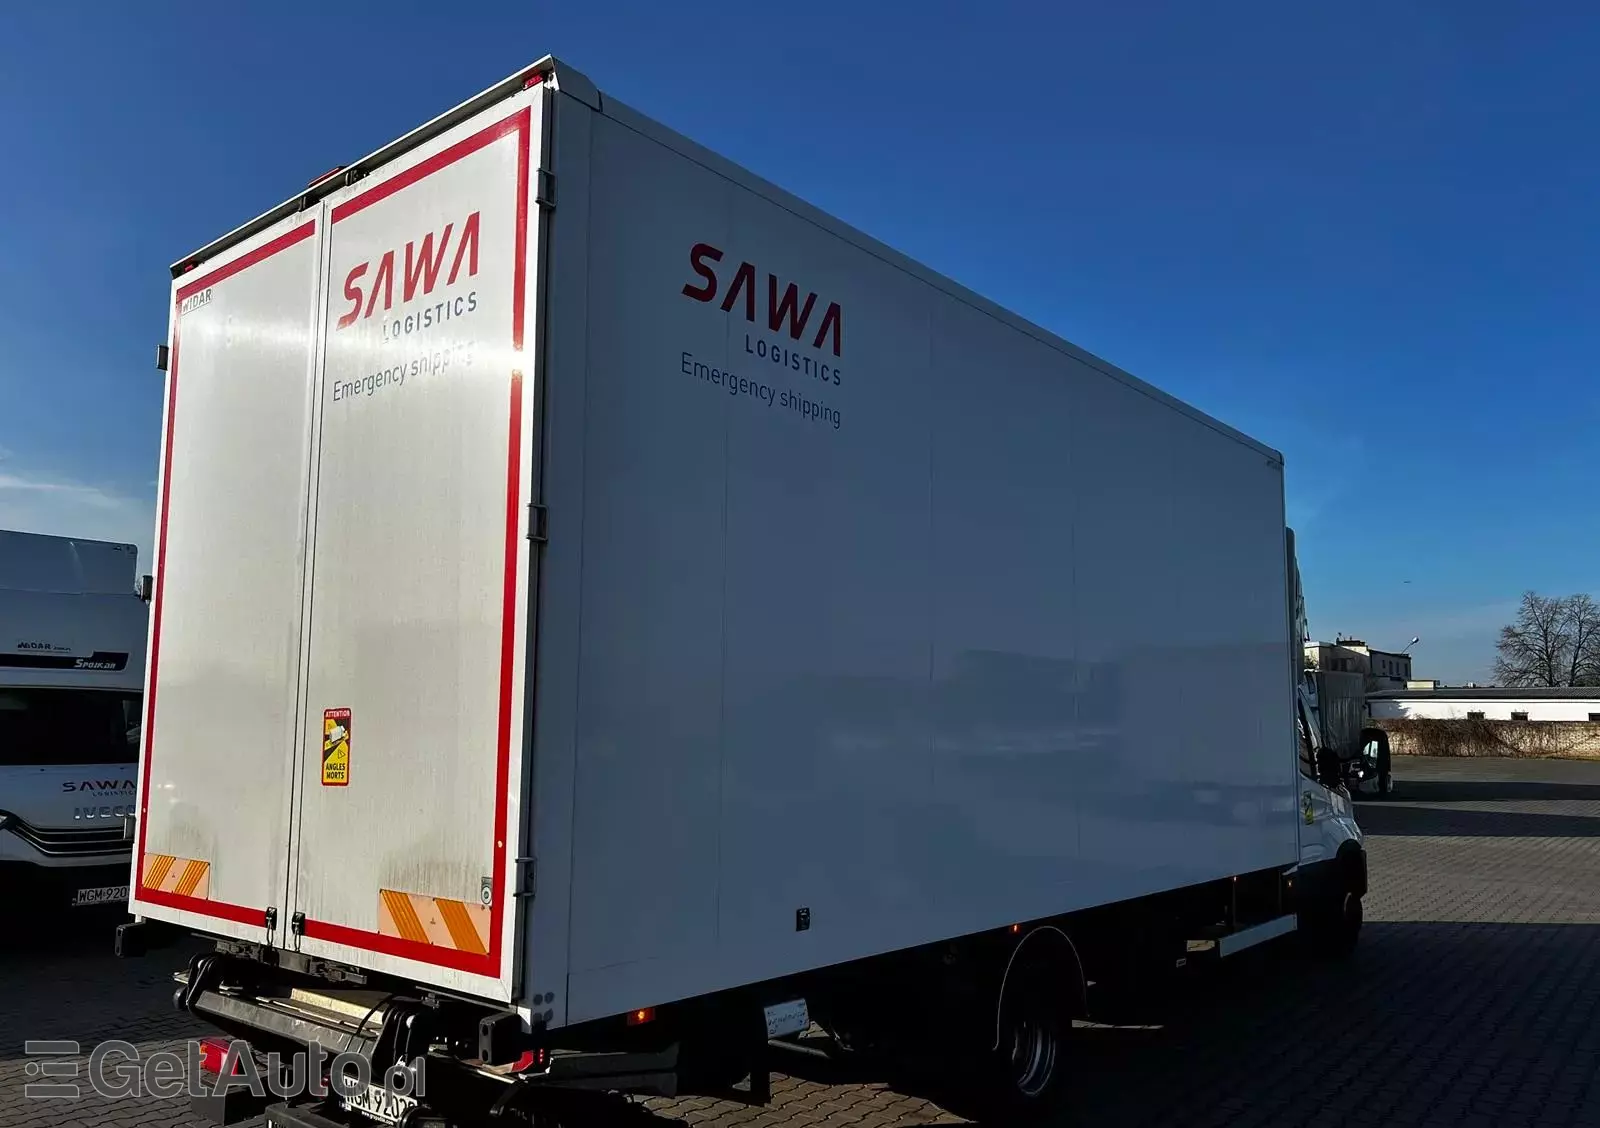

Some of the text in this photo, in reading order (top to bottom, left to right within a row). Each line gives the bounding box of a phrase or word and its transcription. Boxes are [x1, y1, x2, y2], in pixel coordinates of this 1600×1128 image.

[336, 210, 480, 331] SAWA
[382, 291, 478, 344] LOGISTICS
[681, 243, 842, 358] SAWA
[332, 338, 476, 402] Emergency shipp
[745, 333, 842, 387] LOGISTICS
[681, 351, 842, 431] Emergency shipping
[325, 710, 350, 718] ATTENTION
[325, 763, 346, 771] ANGLES
[326, 771, 345, 779] MORTS
[62, 780, 136, 793] SAWA
[92, 789, 136, 797] LOGISTIC
[79, 886, 131, 902] WGM 920
